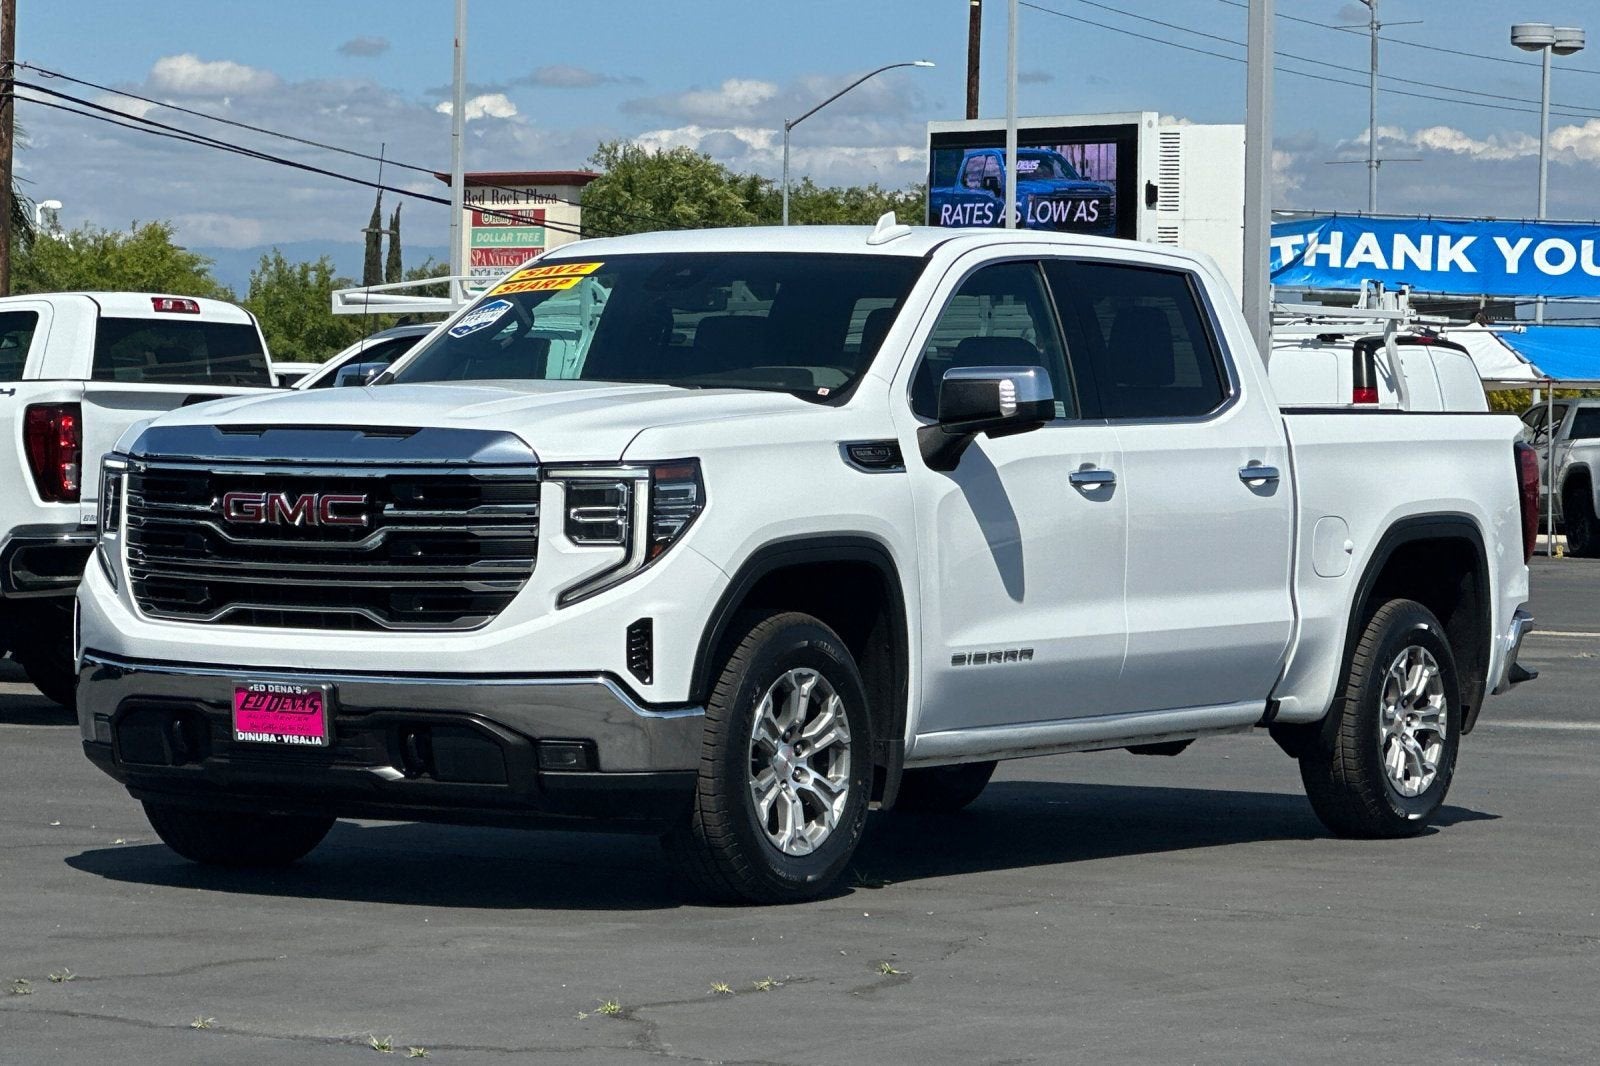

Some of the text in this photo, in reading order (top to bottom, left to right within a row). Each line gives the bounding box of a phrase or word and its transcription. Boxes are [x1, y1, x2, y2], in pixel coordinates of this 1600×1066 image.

[464, 188, 557, 206] Red Rock Plaza
[940, 202, 994, 225] RATES
[1027, 200, 1072, 223] LOW
[1074, 200, 1099, 222] AS
[476, 232, 541, 243] DOLLAR TREE
[471, 249, 488, 266] SPA
[488, 252, 514, 266] NAILS
[1270, 231, 1478, 273] THANK
[519, 264, 594, 279] SAVE
[496, 279, 572, 294] SHARP
[223, 492, 369, 526] GMC
[951, 649, 1034, 667] SIERRA
[253, 684, 303, 694] ED DENA'S
[237, 732, 323, 745] DINUBA VISALIA
